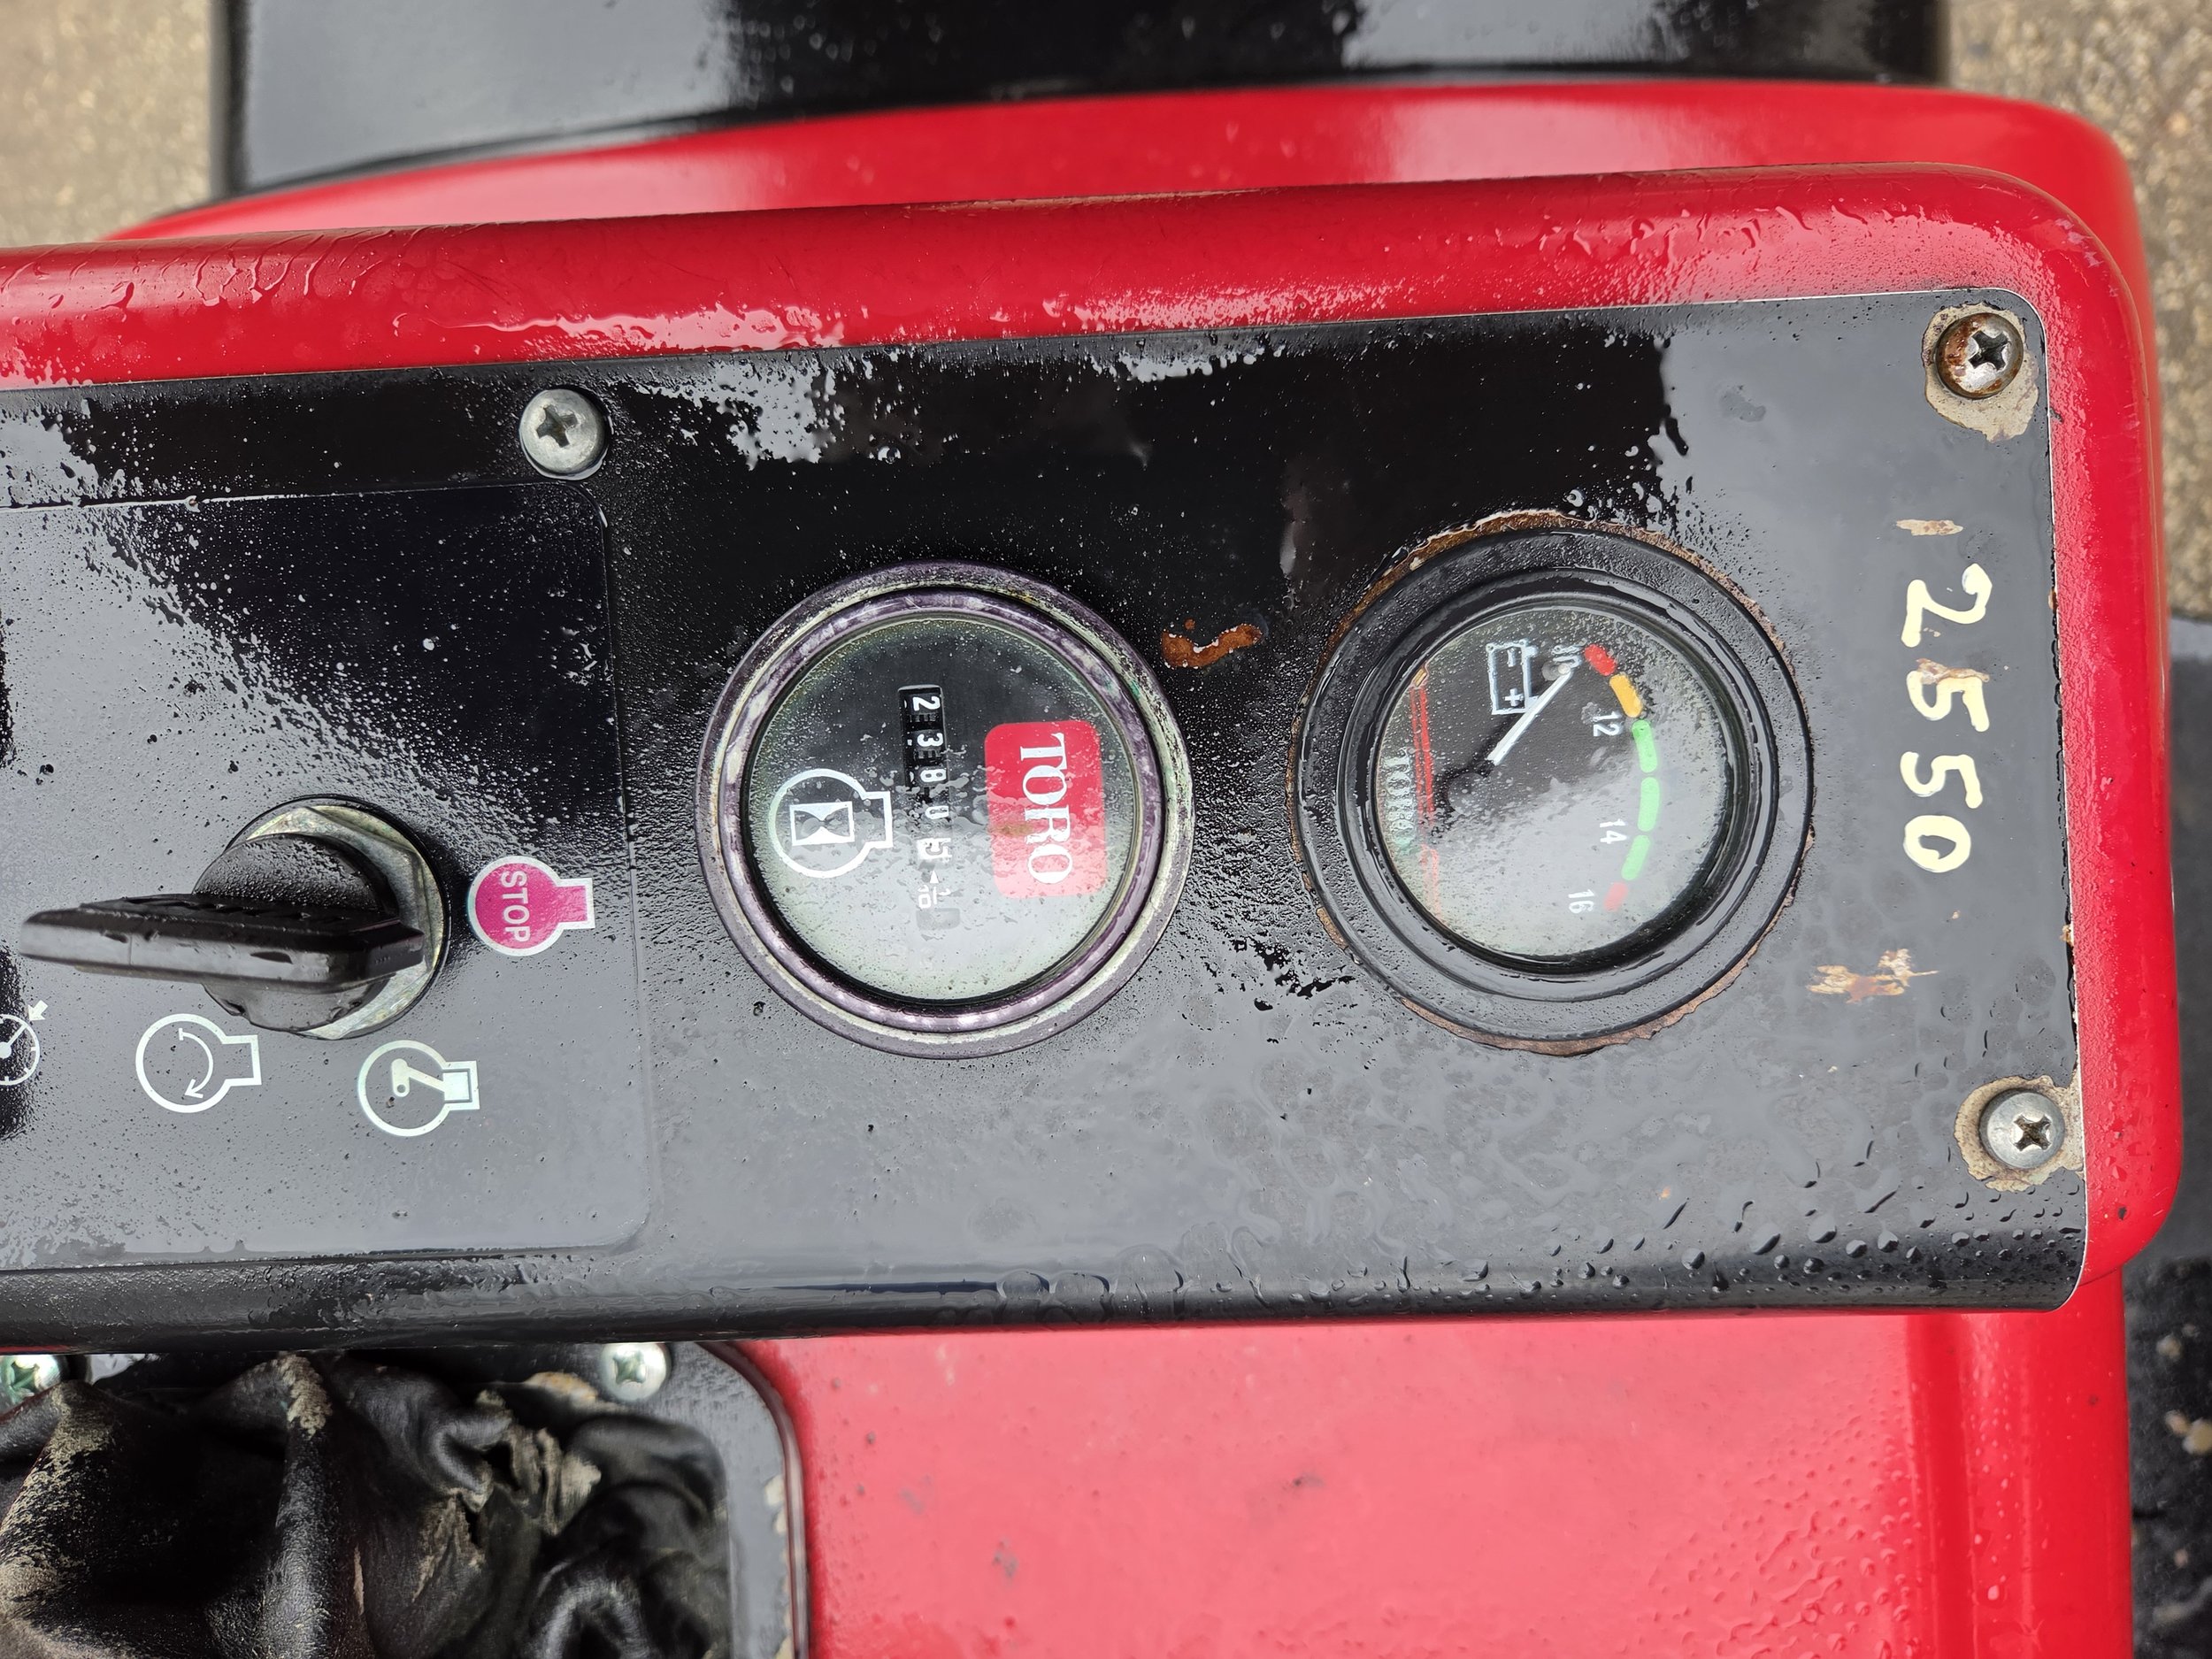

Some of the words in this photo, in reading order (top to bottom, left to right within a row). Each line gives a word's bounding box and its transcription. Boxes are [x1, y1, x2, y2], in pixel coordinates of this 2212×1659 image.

[1593, 710, 1622, 737] 12
[1901, 563, 1993, 873] 2550
[1019, 732, 1073, 884] TORO
[1599, 818, 1627, 844] 14
[501, 871, 531, 942] STOP
[1568, 889, 1595, 914] 16
